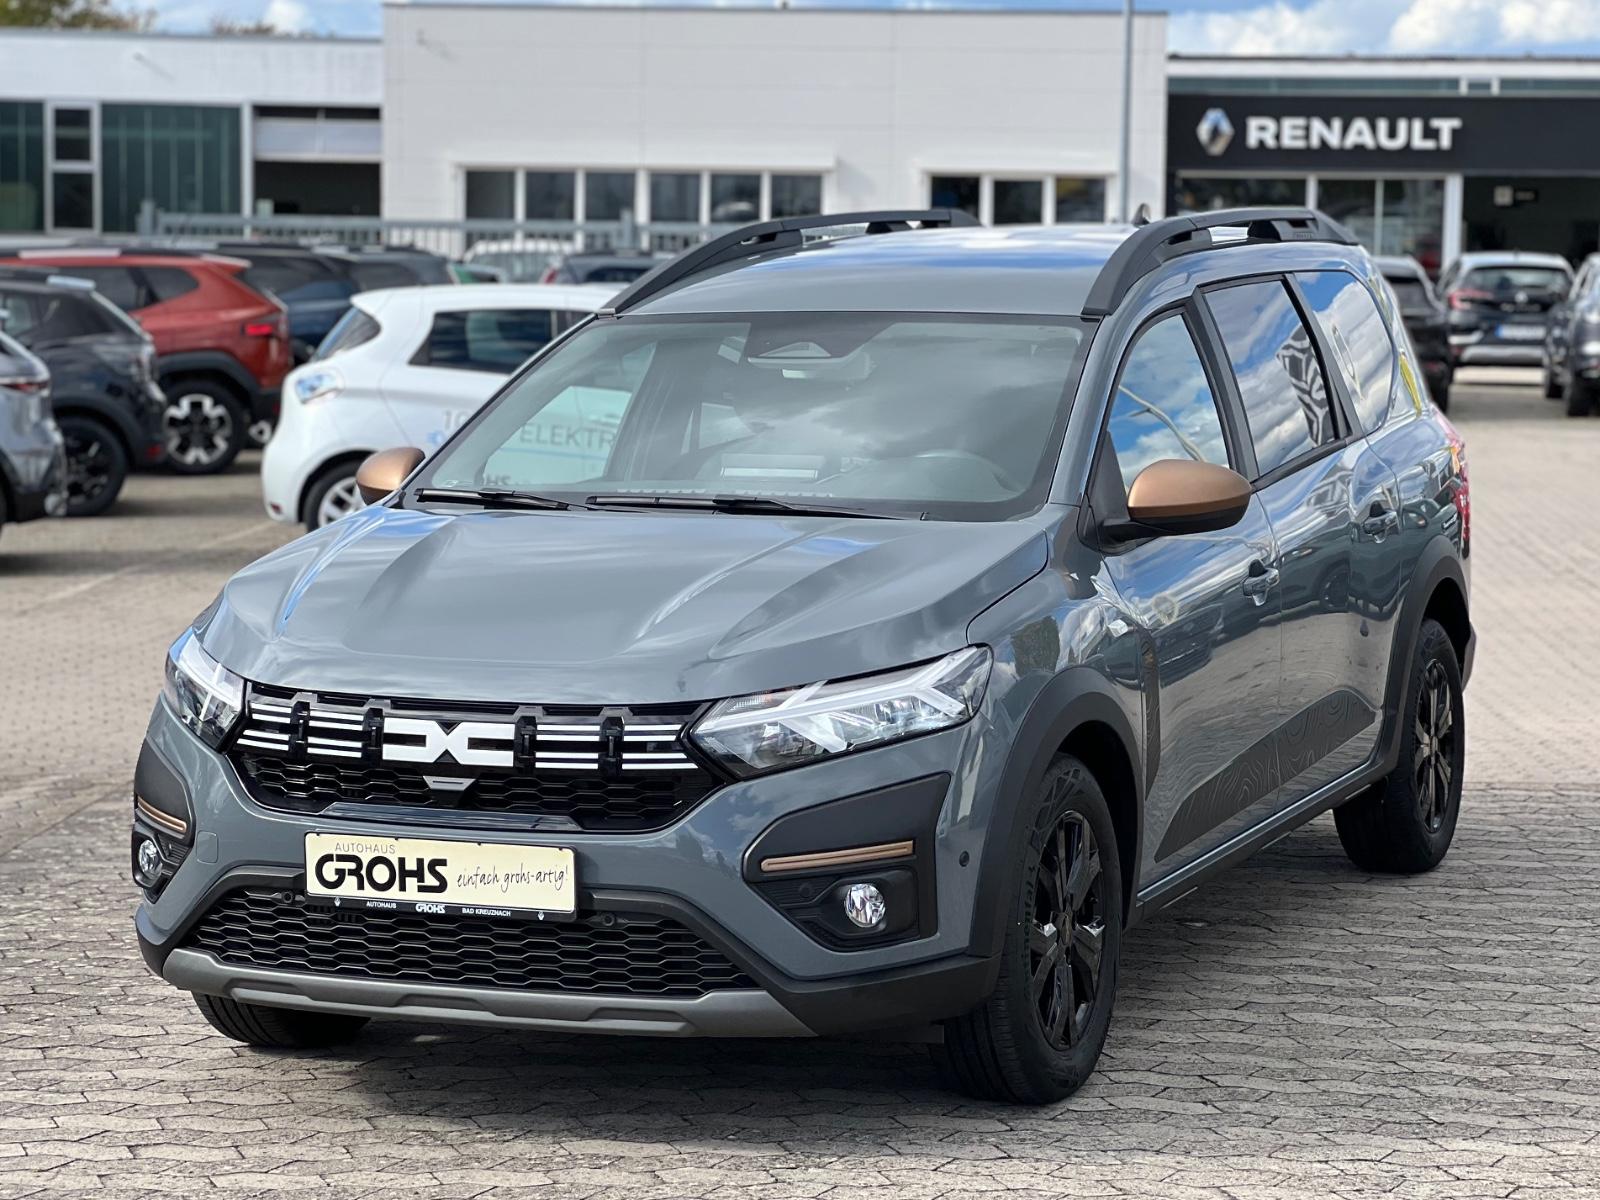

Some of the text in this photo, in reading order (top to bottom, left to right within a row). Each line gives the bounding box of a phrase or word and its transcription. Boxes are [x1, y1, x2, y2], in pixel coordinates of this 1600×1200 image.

[1246, 116, 1462, 150] RENAULT
[520, 423, 616, 449] ELEKTR
[335, 842, 396, 854] AUTOHAUS
[315, 853, 448, 893] GROHS
[457, 862, 568, 893] einfach grohs-artig!
[366, 901, 511, 917] AUTOHAUS GROHS BAD KREUZNACH
